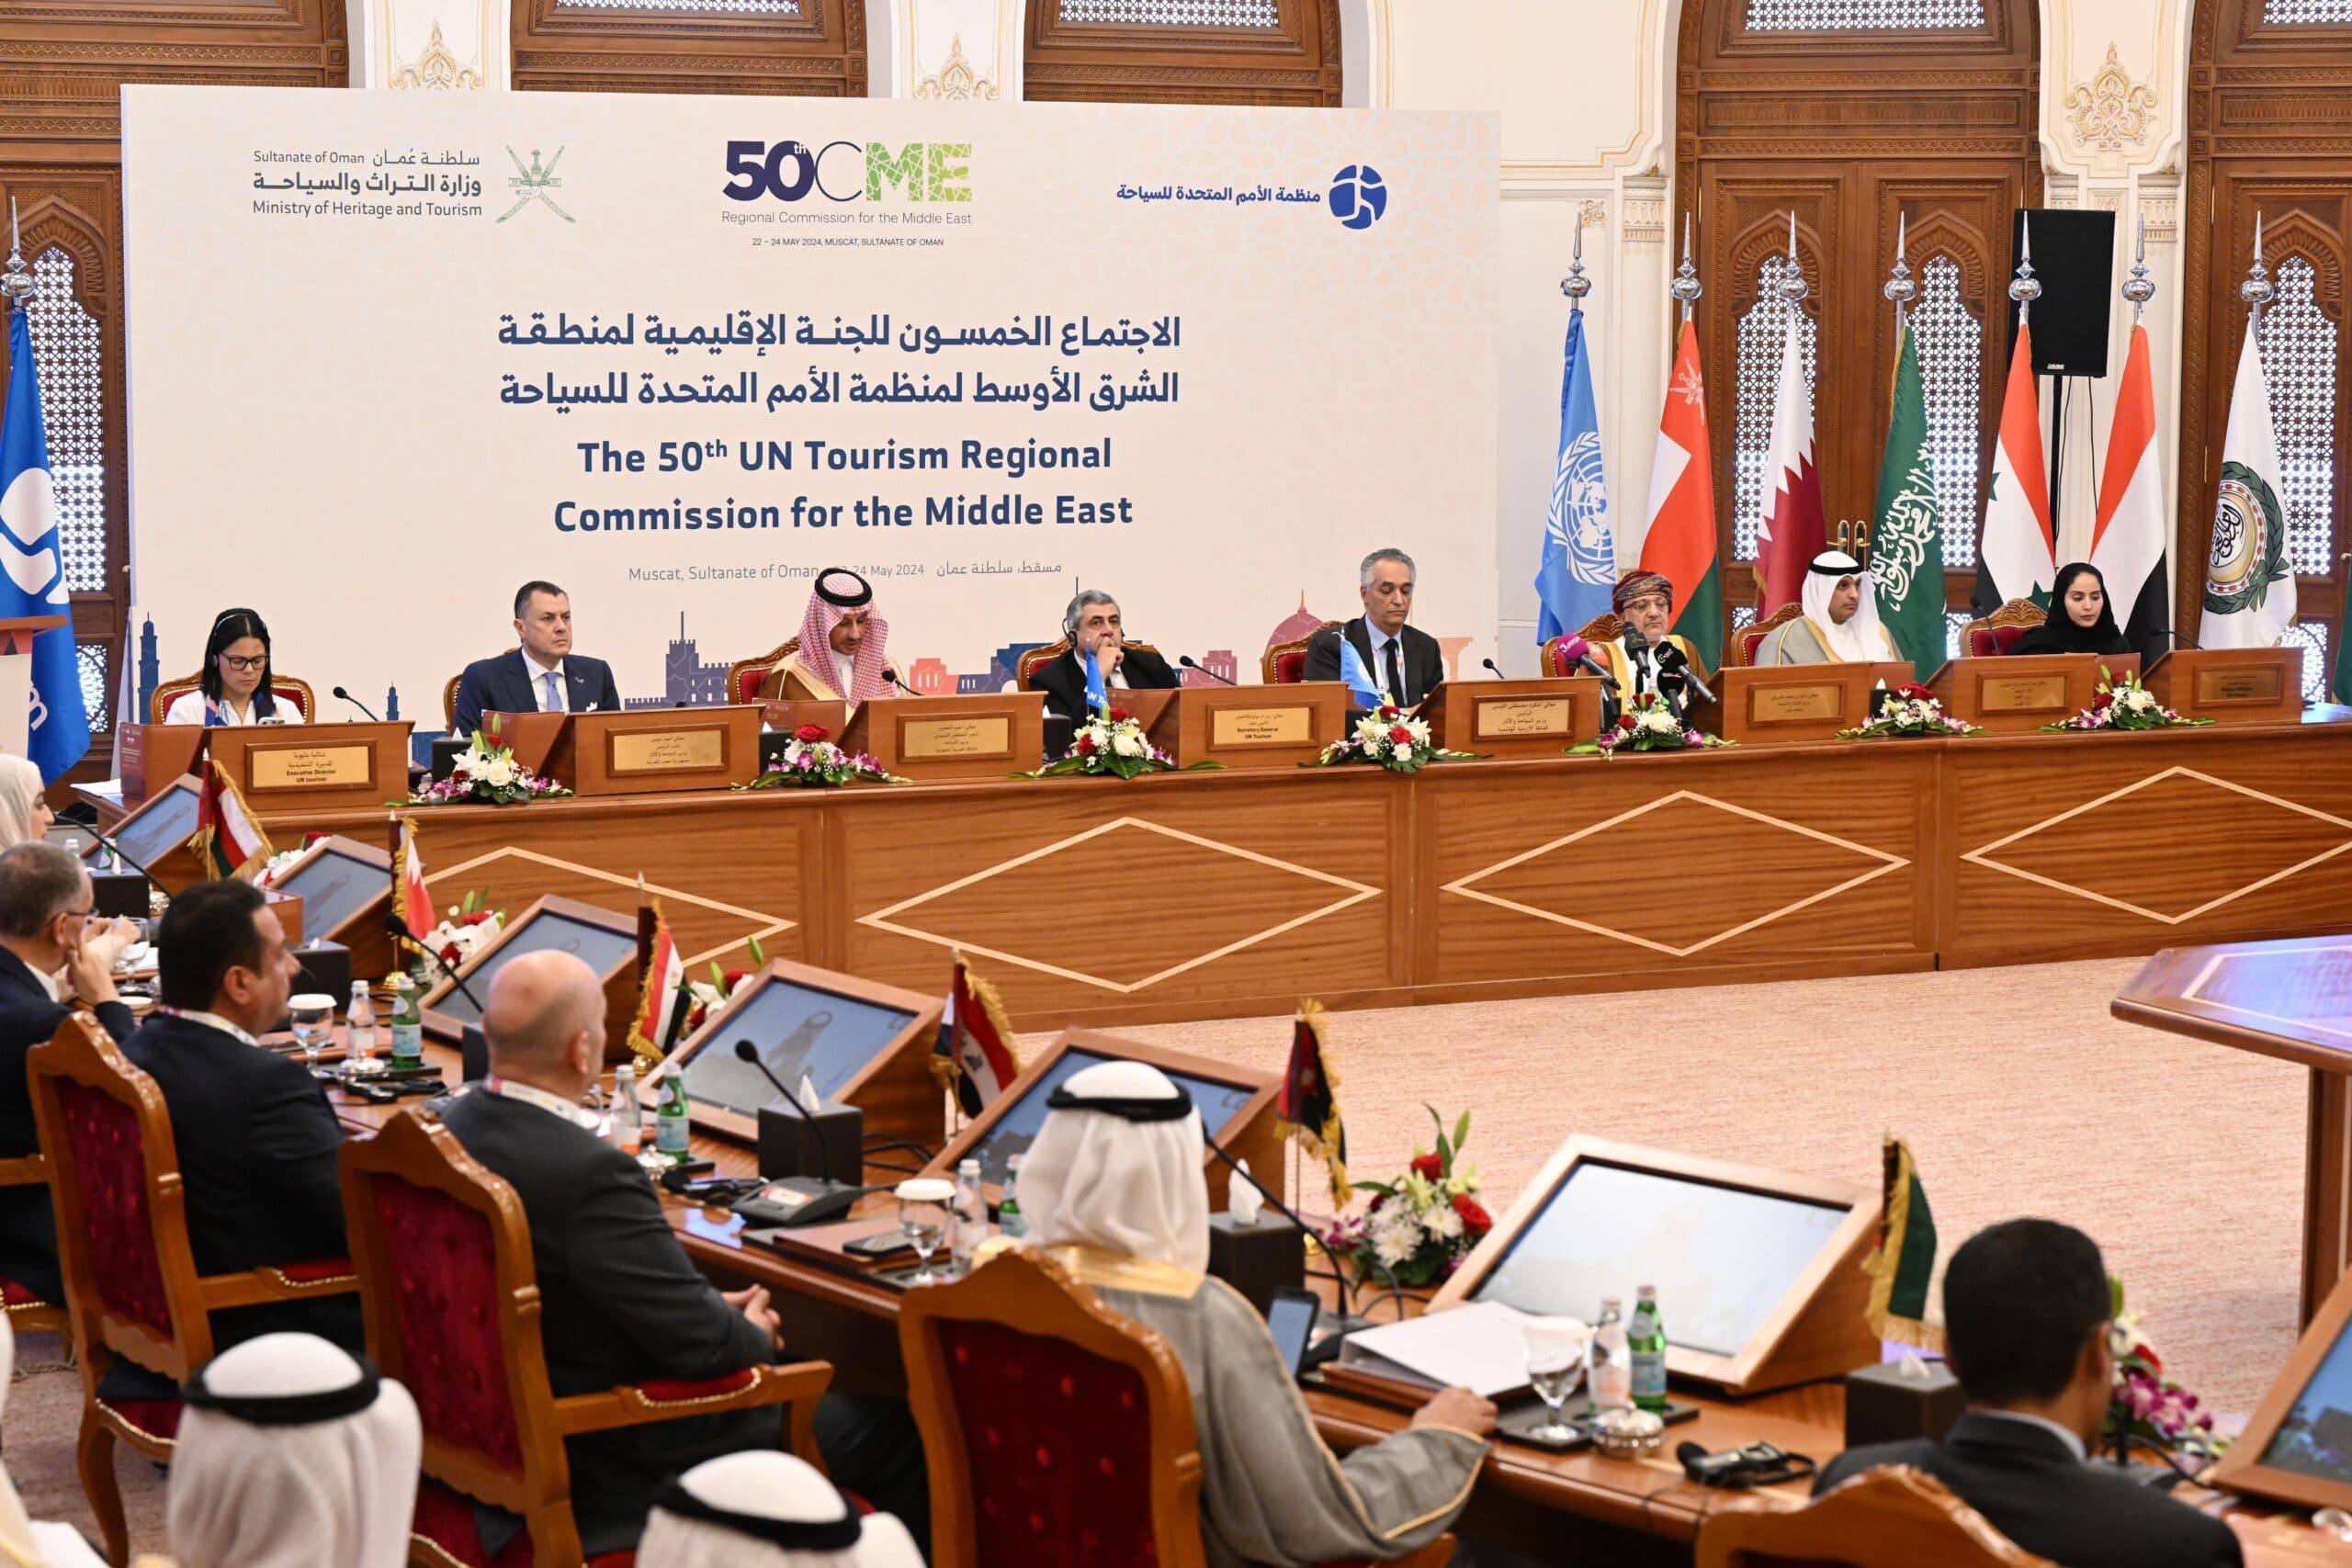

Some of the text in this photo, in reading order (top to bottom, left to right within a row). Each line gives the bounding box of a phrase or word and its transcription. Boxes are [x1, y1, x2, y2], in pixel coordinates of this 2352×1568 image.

[254, 151, 364, 163] Sultanate of Oman
[421, 151, 480, 165] سلطنة
[254, 172, 481, 197] وزارة التراث والسياحة
[1117, 185, 1320, 206] منظمة الأمم المتحدة للسياحة
[254, 200, 481, 219] Ministry of Heritage and Tourism
[722, 211, 971, 225] Regional Commission for the Middle East
[825, 238, 859, 246] MUSCAT,
[499, 310, 1180, 356] الاجتماع الخمسون للجنة الإقليمية لمنطقة
[501, 366, 1178, 414] الشرق الأوسط لمنظمة الأمم المتحدة للسياحة
[577, 437, 1110, 478] The 50th UN Tourism Regional
[555, 494, 1132, 532] Commission for the Middle East
[629, 568, 684, 581] Muscat,
[689, 566, 756, 580] Sultanate
[761, 564, 775, 578] of
[871, 566, 892, 578] May
[896, 564, 924, 575] 2024
[937, 561, 967, 577] عمان
[972, 560, 1012, 573] سلطنة
